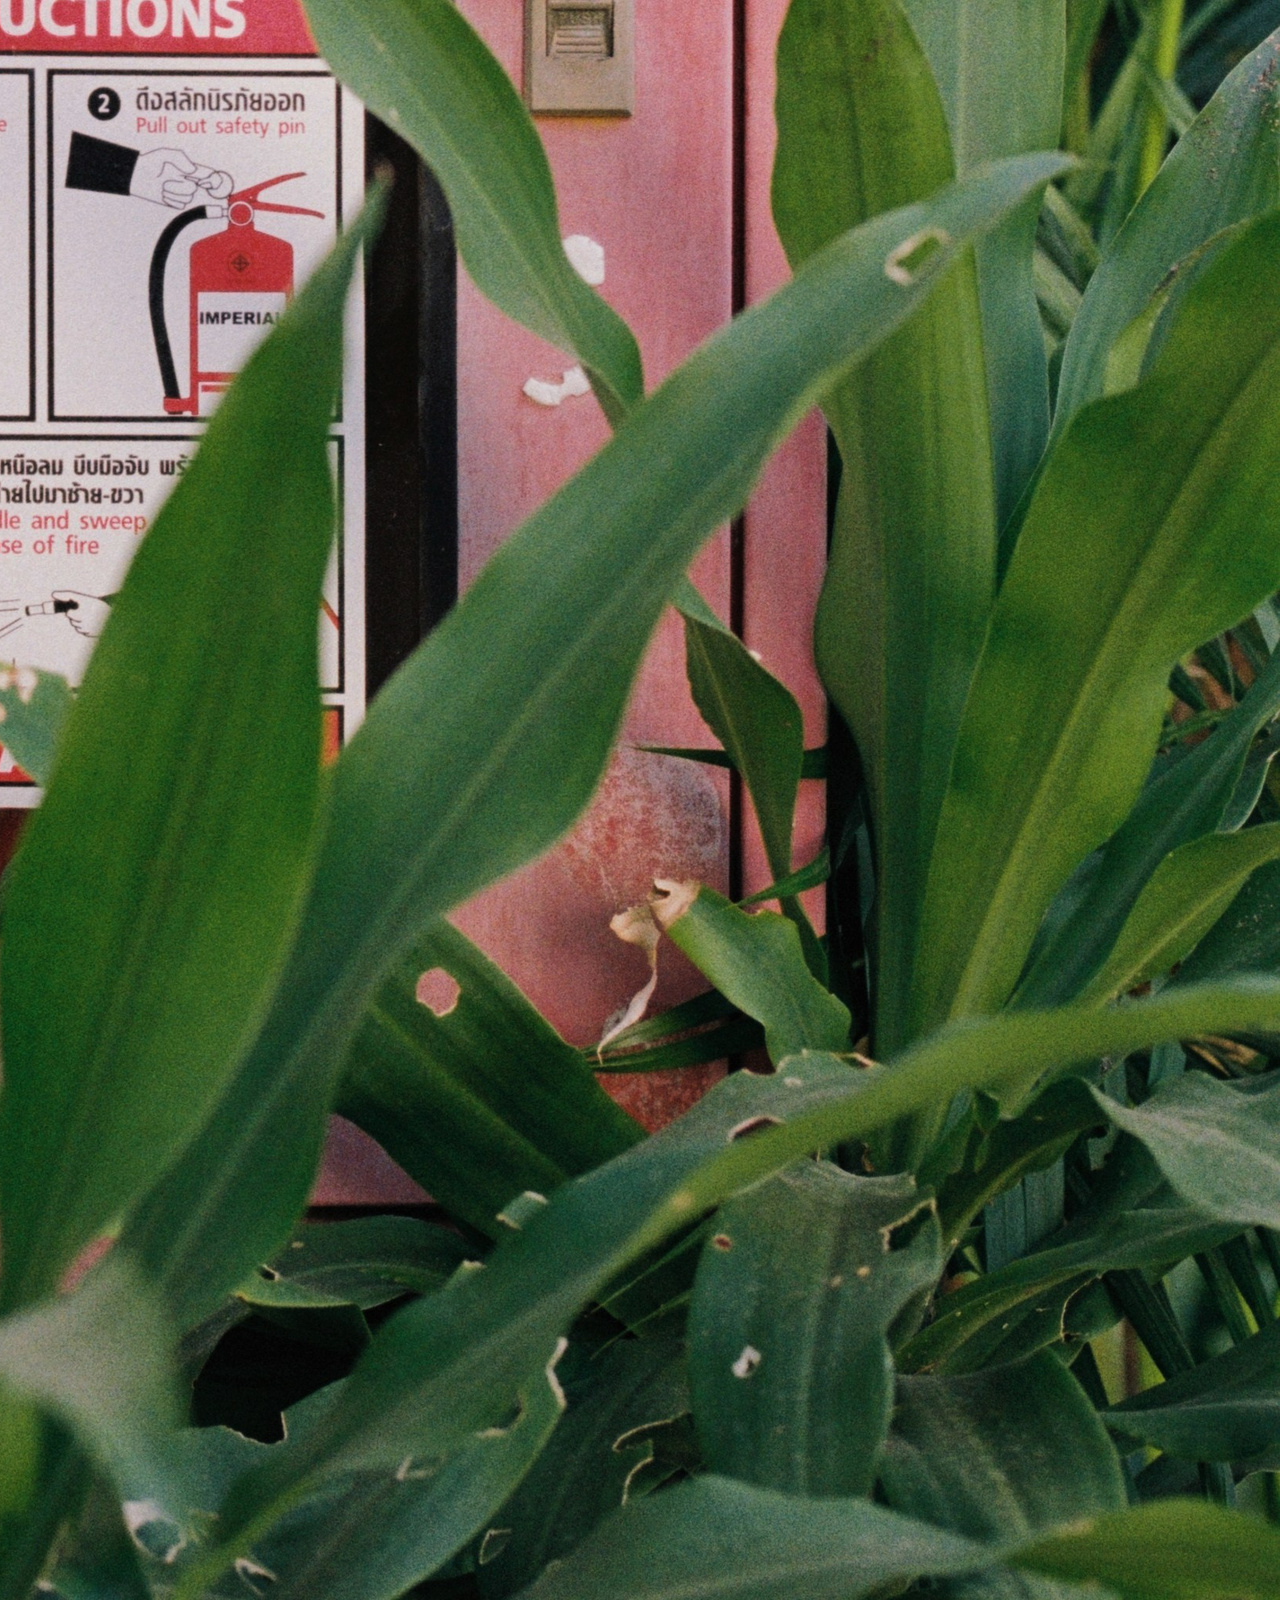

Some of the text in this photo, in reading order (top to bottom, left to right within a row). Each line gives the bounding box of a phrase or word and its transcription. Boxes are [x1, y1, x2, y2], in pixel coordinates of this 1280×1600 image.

[135, 85, 306, 112] ดึงสลักนิรภัยออก
[136, 116, 306, 139] Pull out safety pin
[73, 454, 150, 476] บีบมือจับ
[160, 453, 193, 476] พร้
[31, 510, 70, 530] and
[79, 514, 147, 535] sweep
[32, 534, 56, 555] of
[65, 534, 100, 555] fire
